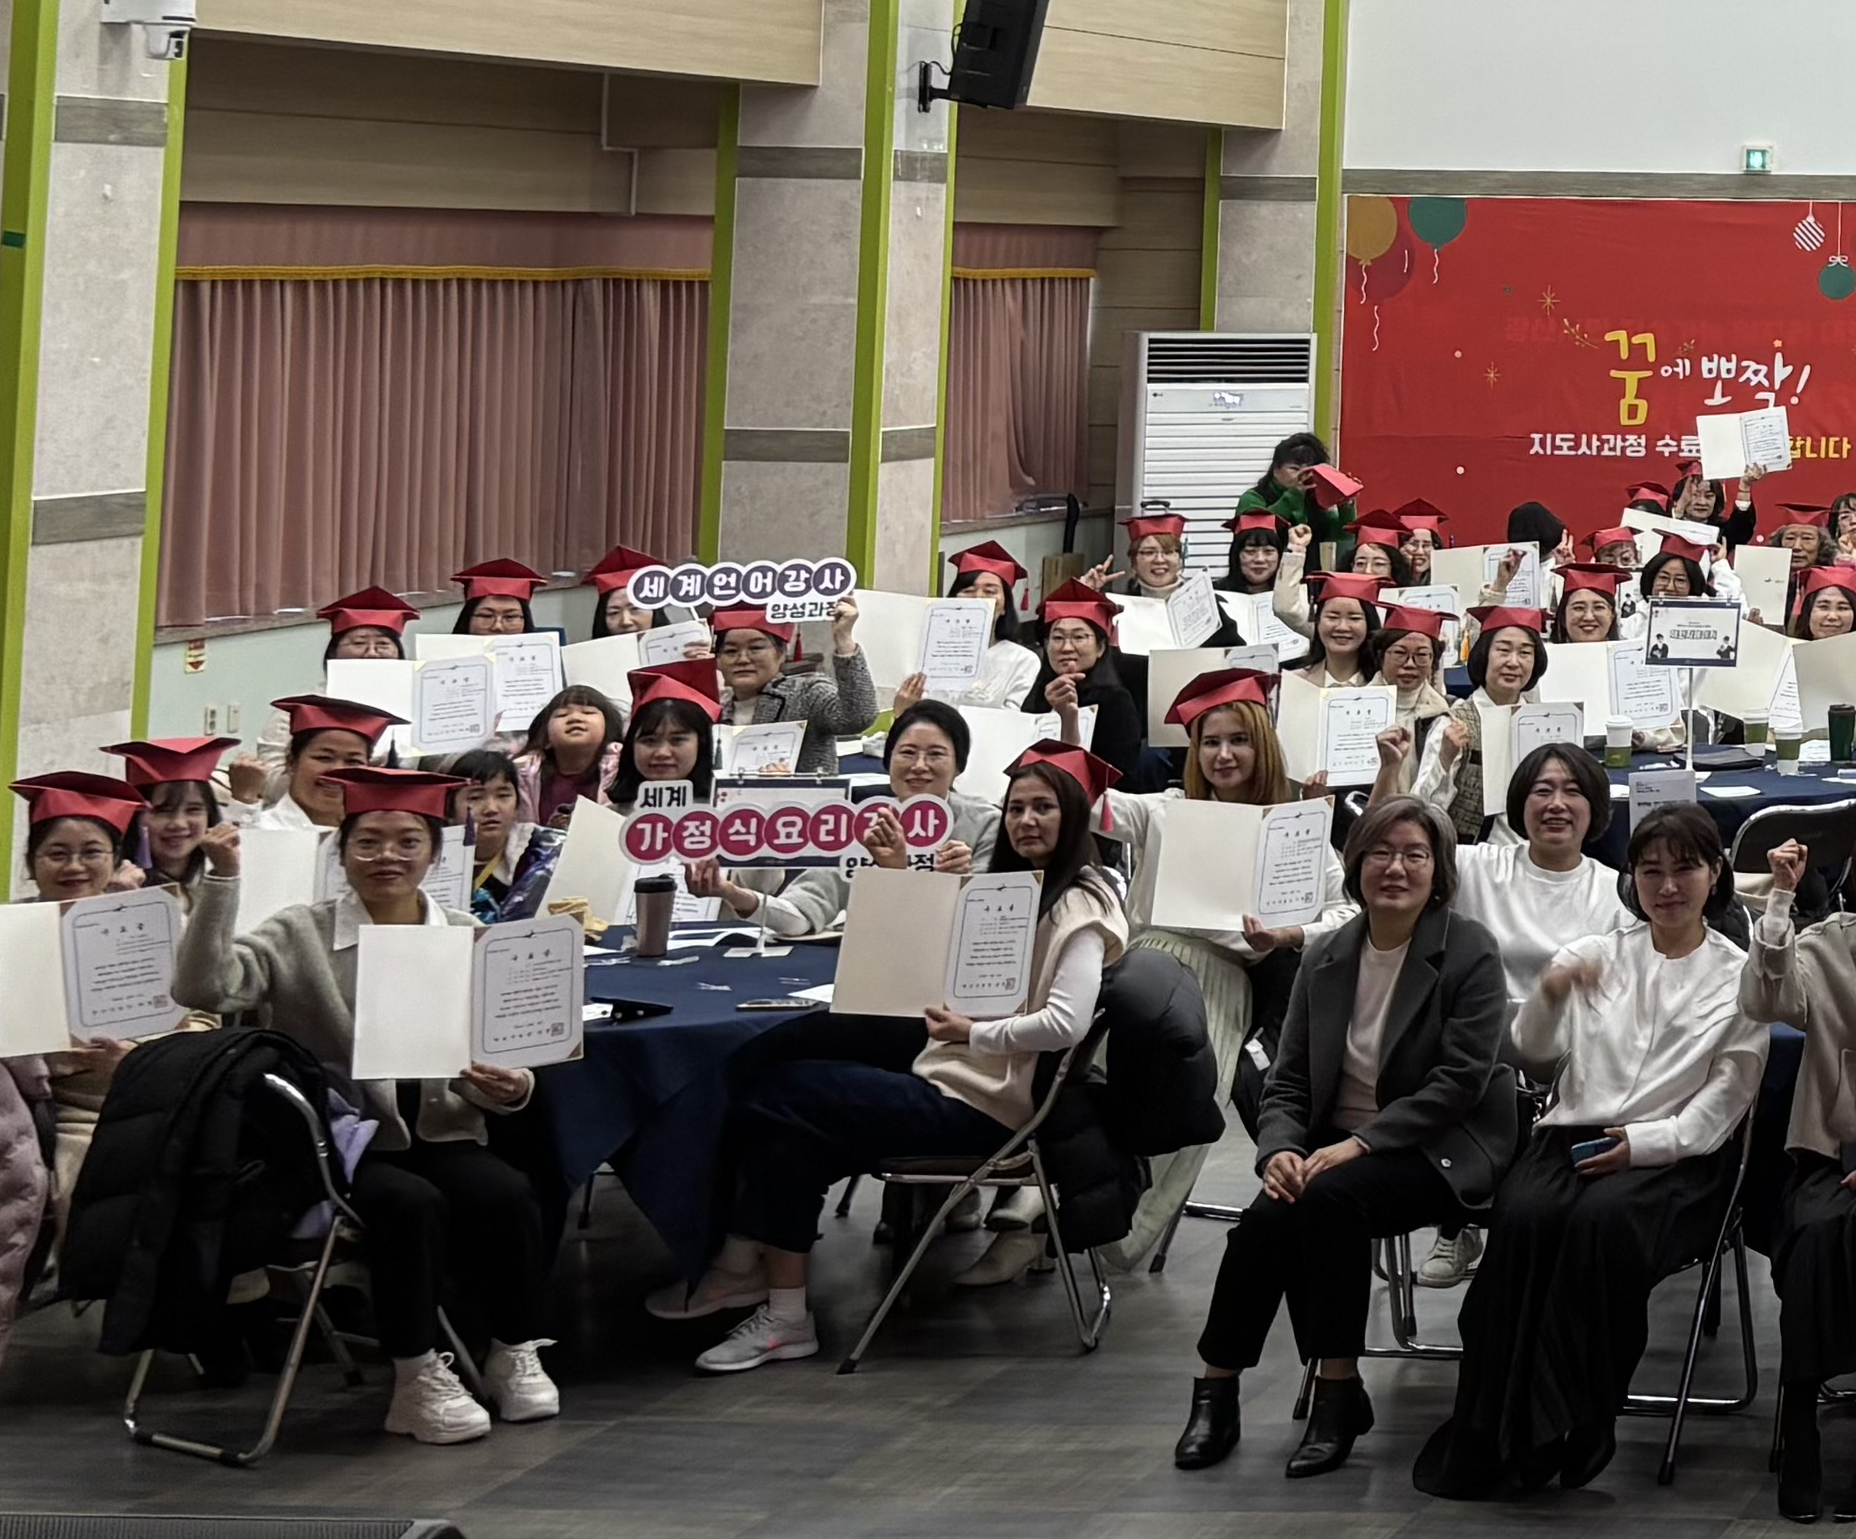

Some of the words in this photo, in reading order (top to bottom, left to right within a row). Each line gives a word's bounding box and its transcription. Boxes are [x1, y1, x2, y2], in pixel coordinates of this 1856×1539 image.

[1604, 330, 1690, 426] 꿈에
[1529, 433, 1647, 457] 지도사과정
[1656, 434, 1701, 457] 수료
[639, 568, 845, 599] 세계언어강사
[640, 786, 687, 808] 세계
